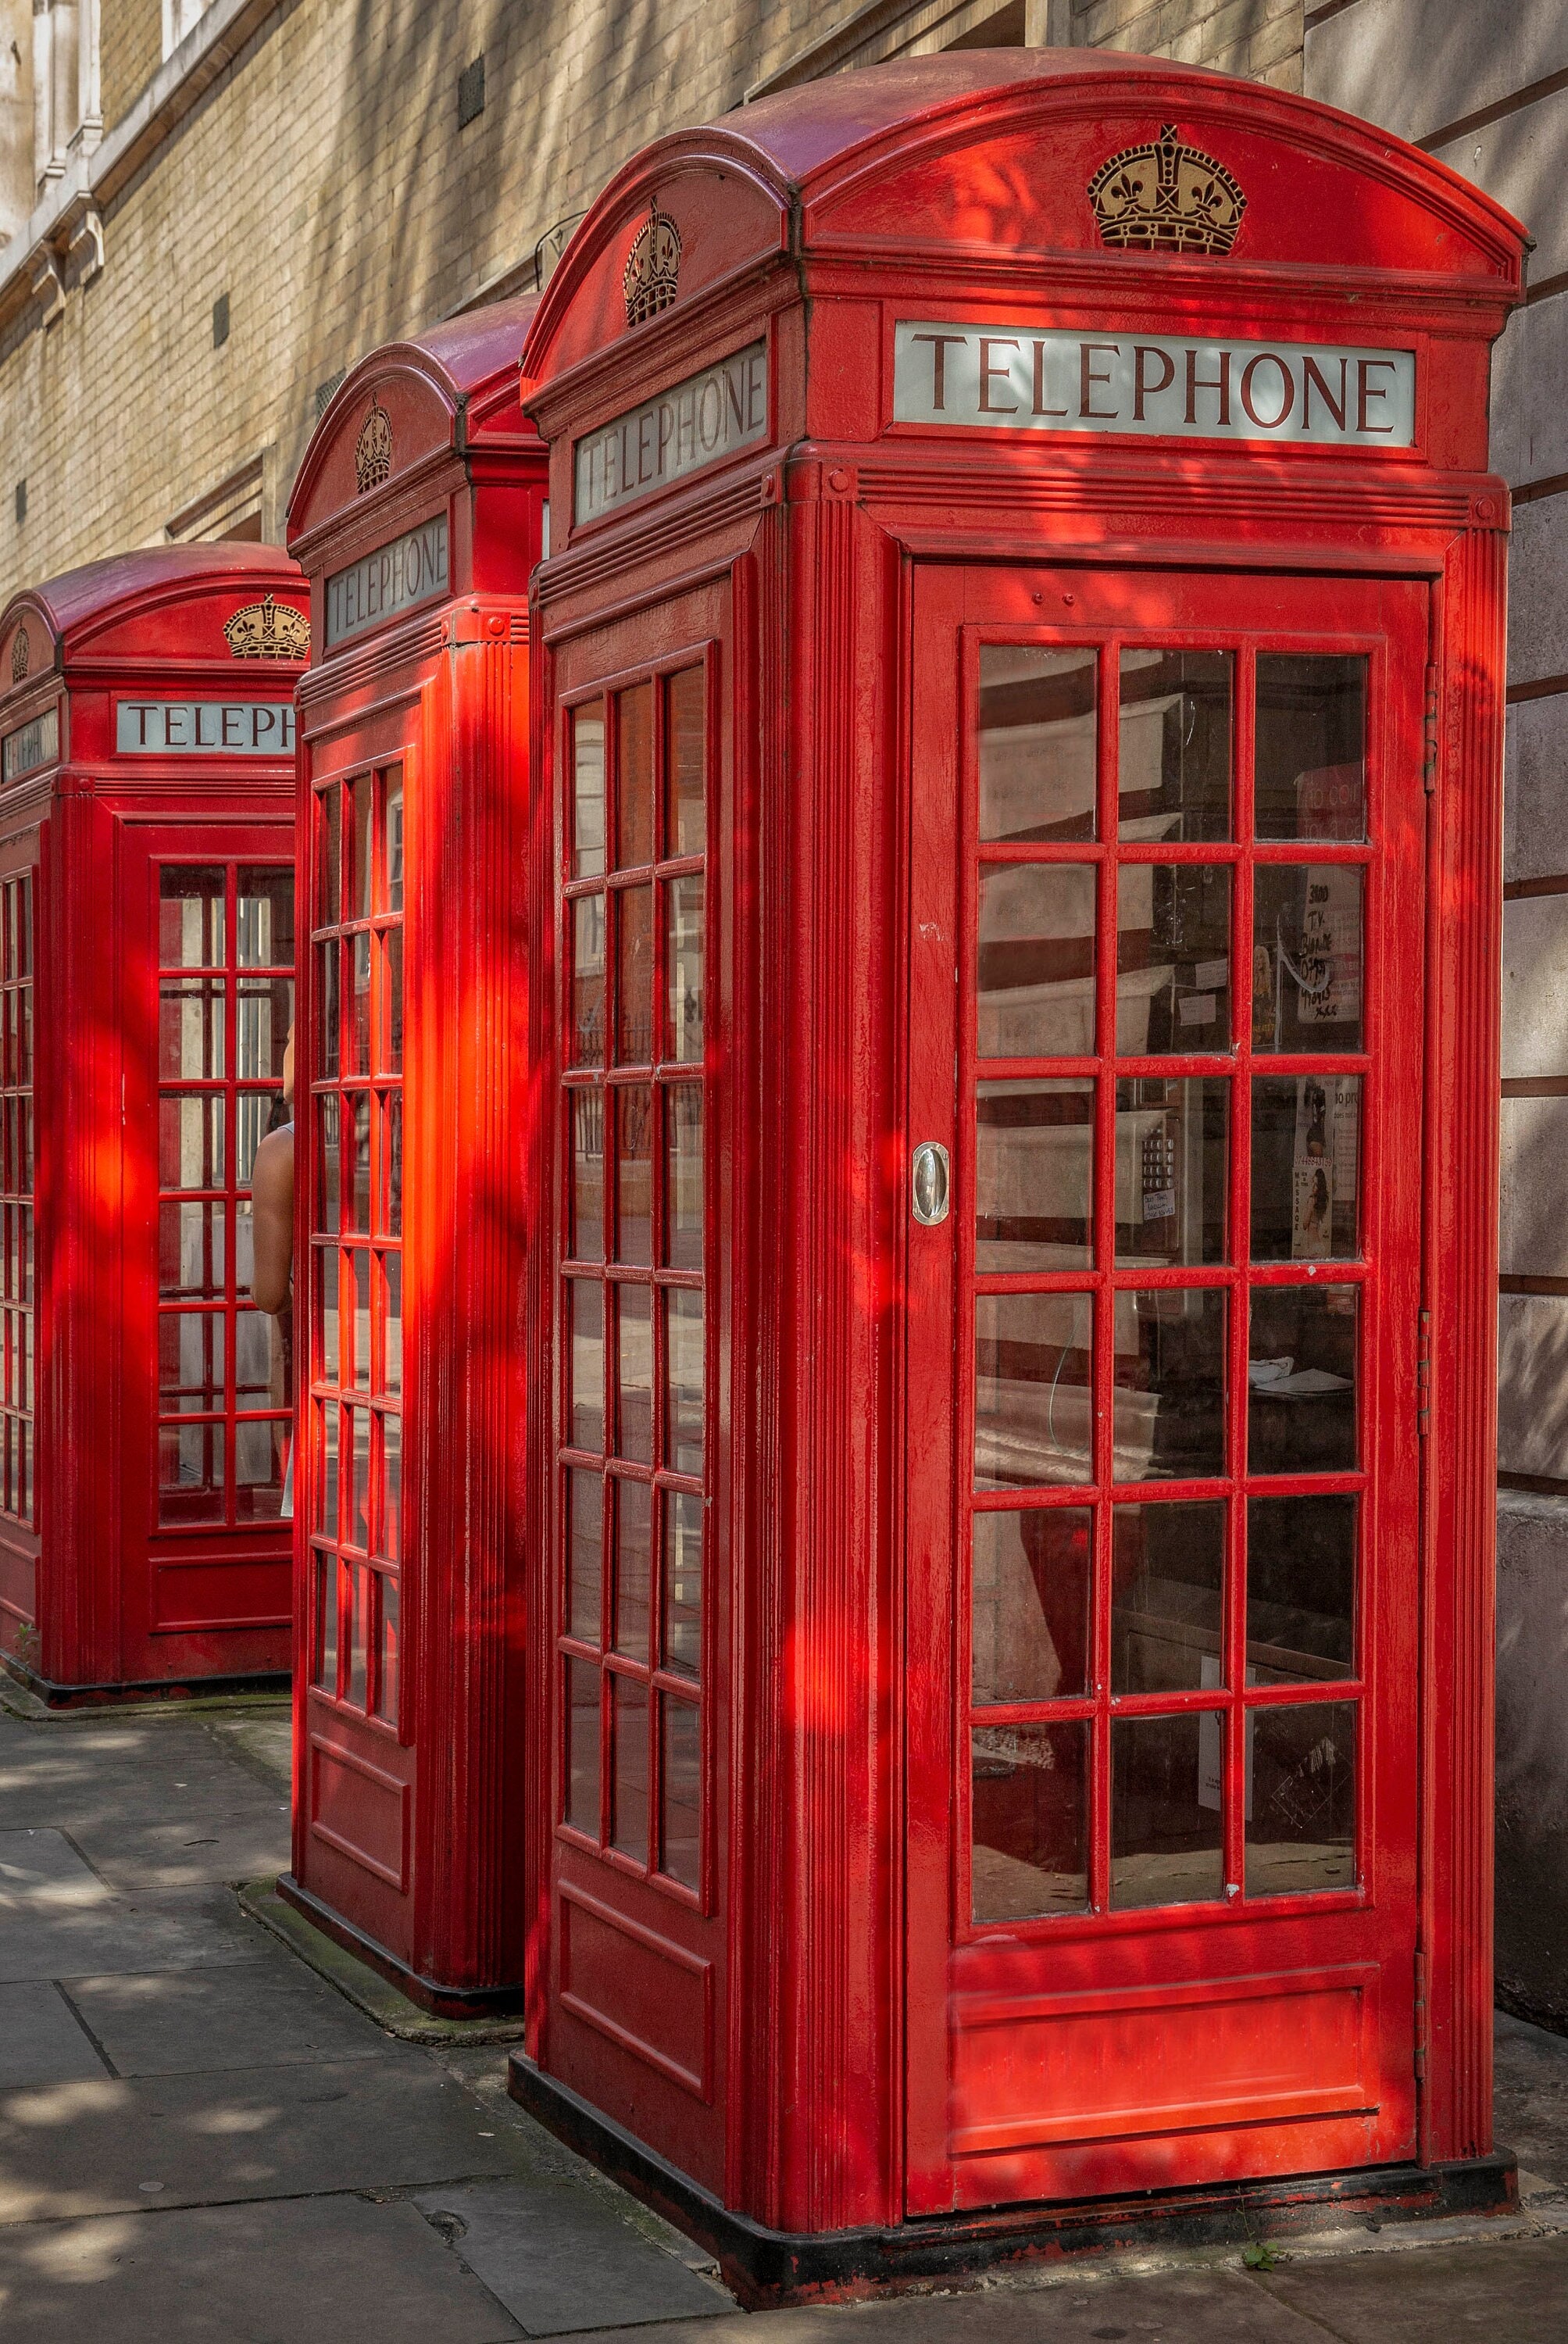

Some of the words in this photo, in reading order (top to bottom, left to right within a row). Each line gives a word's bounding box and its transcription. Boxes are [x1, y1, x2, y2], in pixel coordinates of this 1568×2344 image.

[583, 353, 765, 510] TELEPHONE
[911, 334, 1396, 434] TELEPHONE
[332, 524, 447, 634] TELEPHONE
